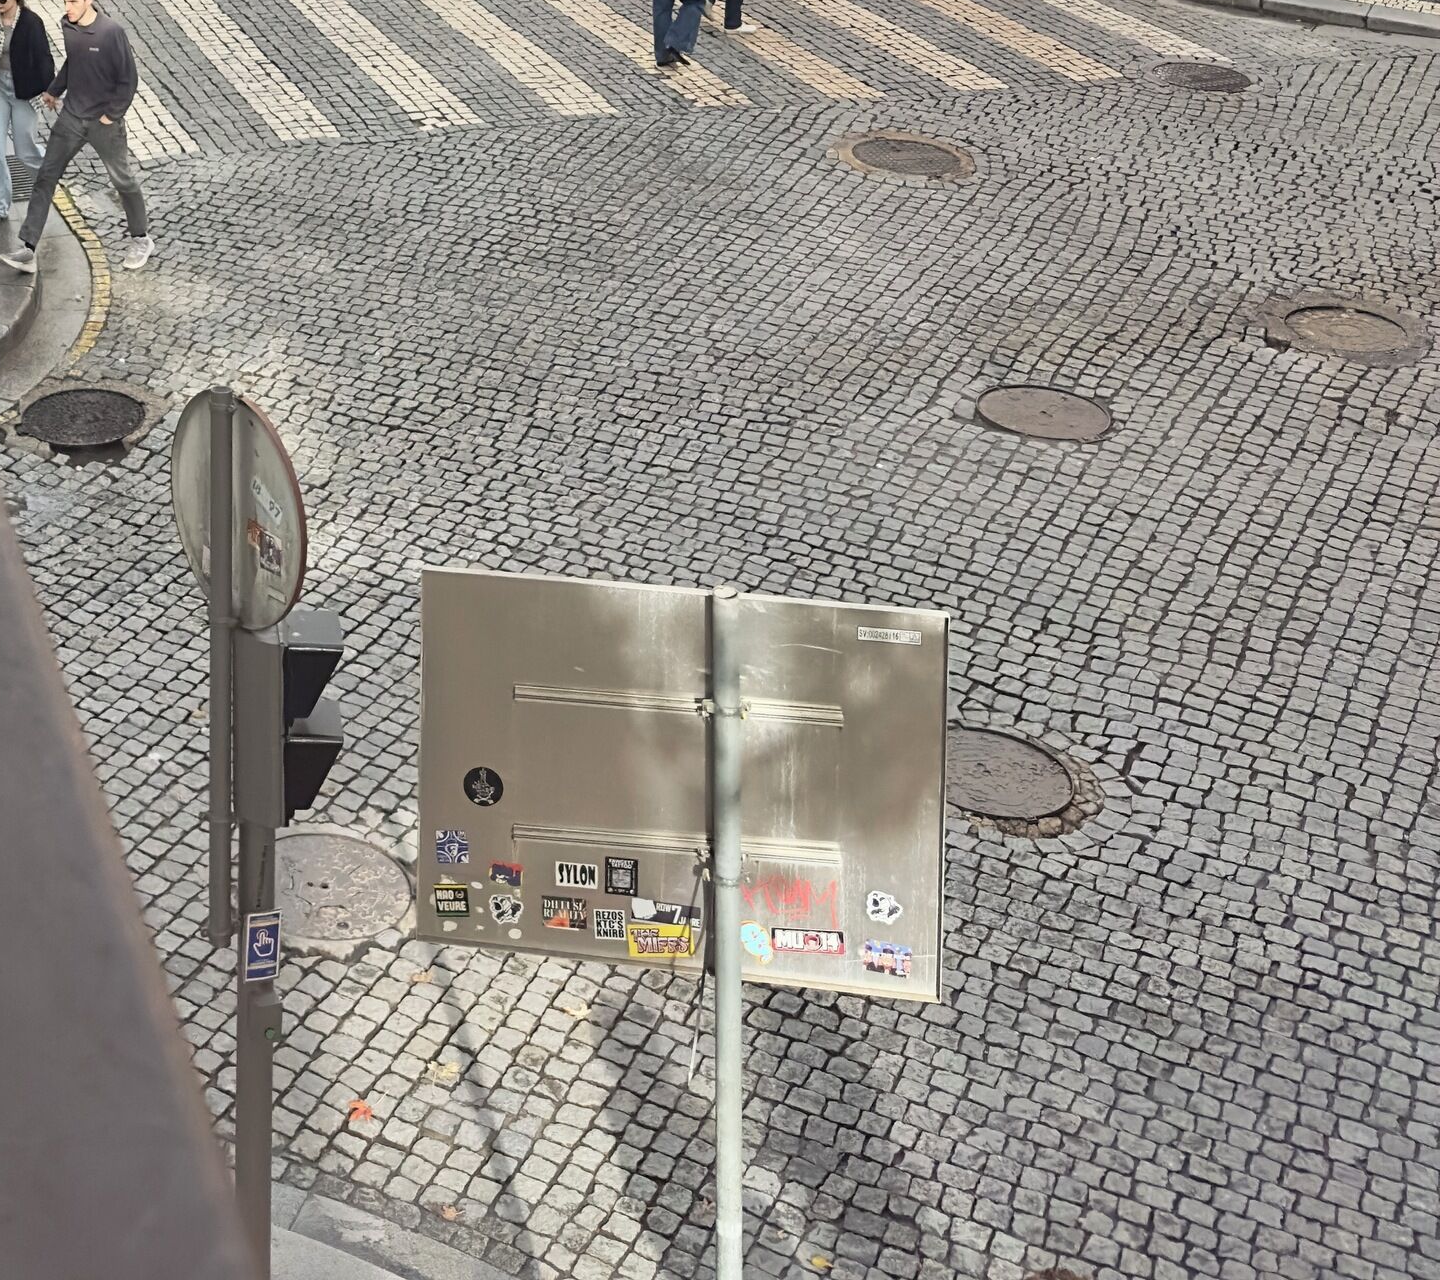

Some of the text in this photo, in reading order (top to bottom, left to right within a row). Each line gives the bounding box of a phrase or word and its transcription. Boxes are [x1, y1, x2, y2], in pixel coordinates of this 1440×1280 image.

[558, 862, 596, 886] SYLON
[596, 910, 624, 921] REZOS
[672, 904, 682, 924] 7
